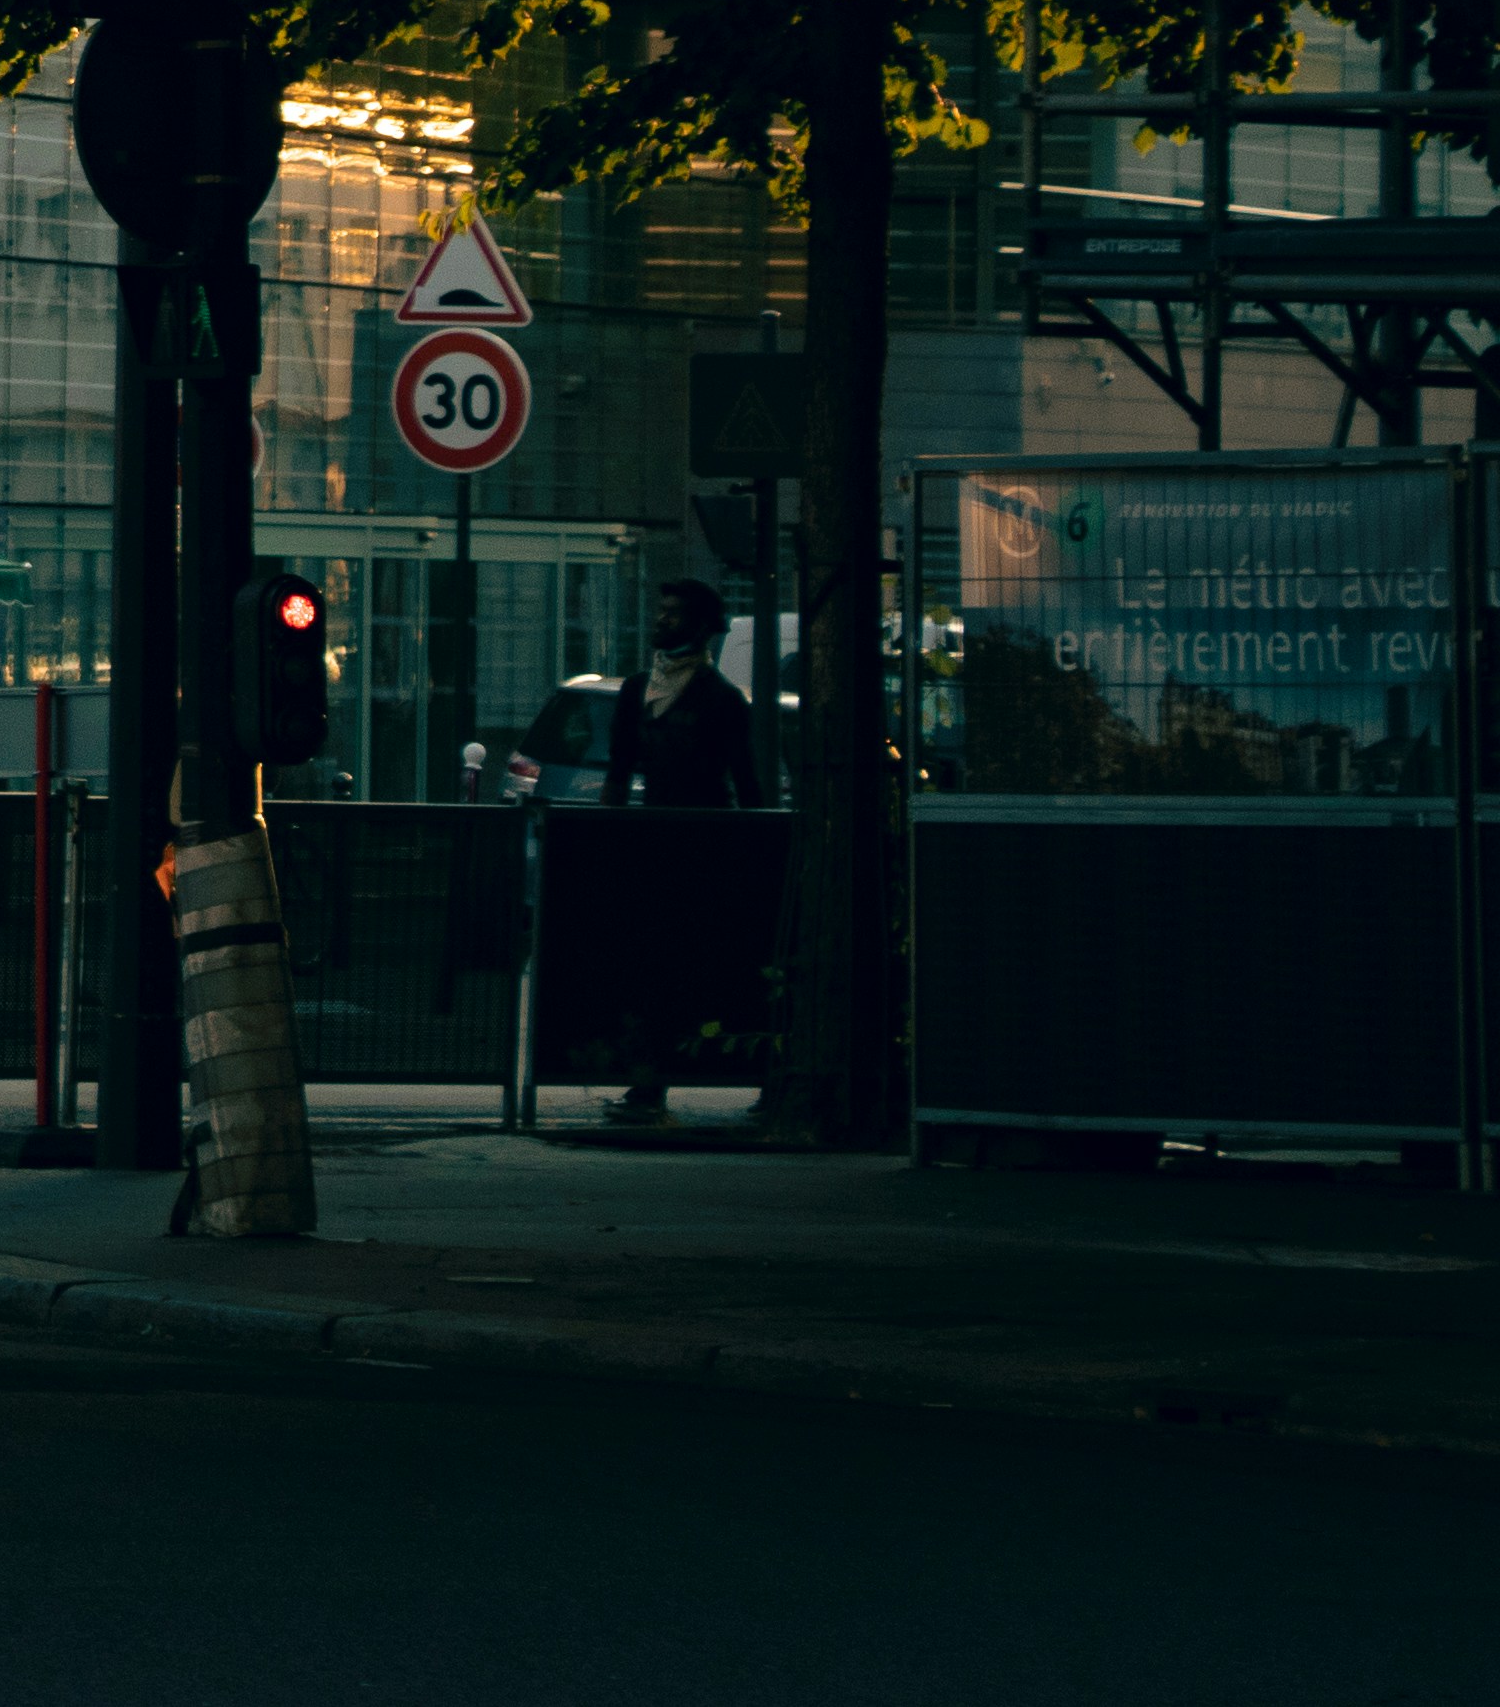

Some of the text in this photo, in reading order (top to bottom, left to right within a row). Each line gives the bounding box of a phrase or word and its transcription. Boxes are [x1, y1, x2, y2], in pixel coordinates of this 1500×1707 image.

[422, 372, 500, 430] 30
[1067, 501, 1092, 543] 6
[1189, 554, 1320, 610] métro
[1340, 566, 1450, 610] avec
[1053, 617, 1351, 674] entièrement
